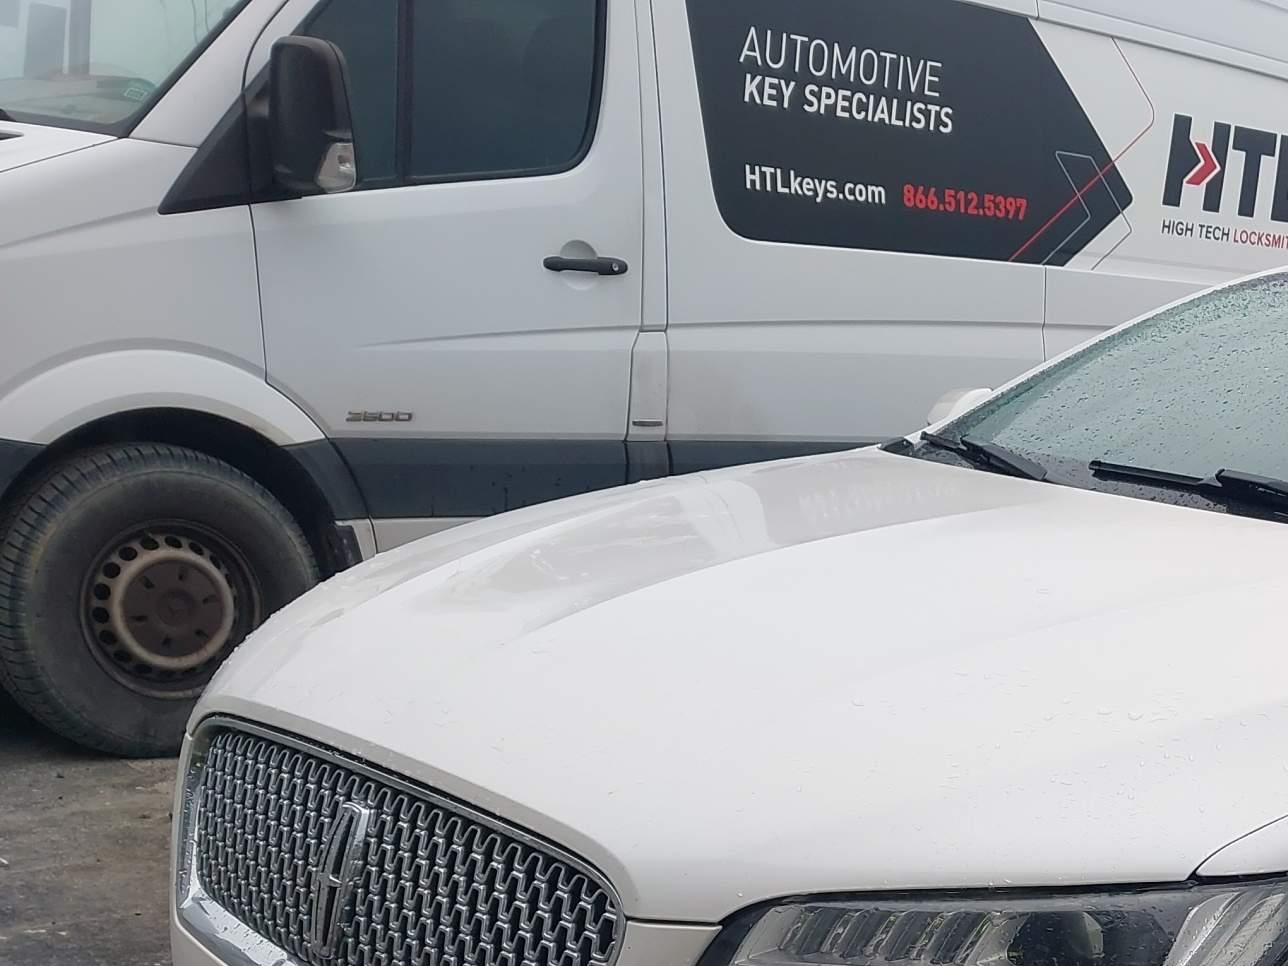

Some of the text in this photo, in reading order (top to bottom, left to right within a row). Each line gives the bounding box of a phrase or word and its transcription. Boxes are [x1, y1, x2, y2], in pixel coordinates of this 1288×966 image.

[738, 26, 943, 97] AUTOMOTIVE
[743, 73, 953, 134] KEY SPECIALISTS
[745, 164, 1028, 221] HTLkeys.com 866.512.5397
[1161, 219, 1195, 239] HIGH
[1198, 223, 1230, 242] TECH
